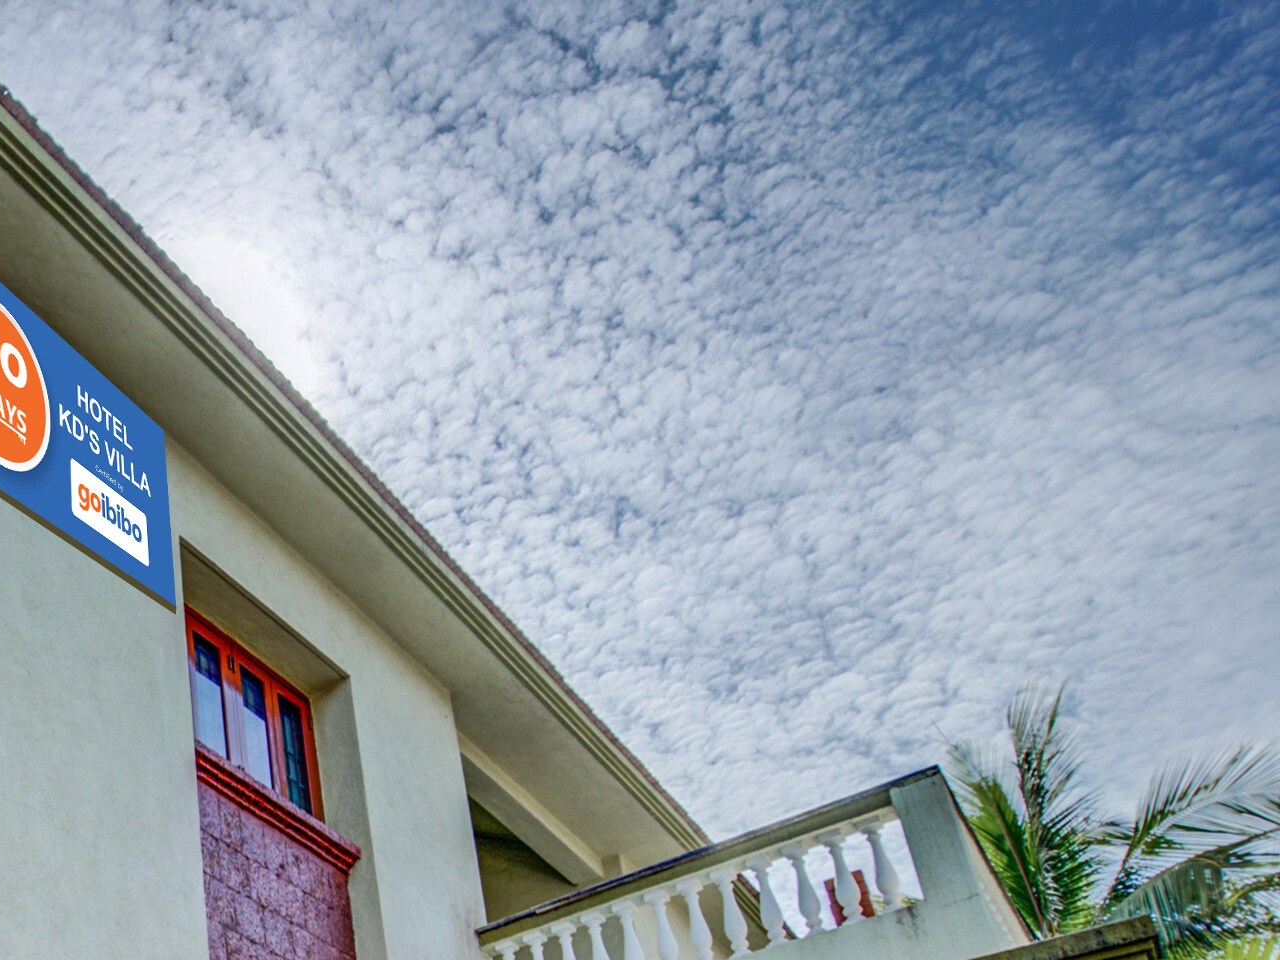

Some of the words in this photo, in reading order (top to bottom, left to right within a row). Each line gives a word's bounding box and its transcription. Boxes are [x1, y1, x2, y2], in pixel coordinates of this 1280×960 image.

[58, 402, 100, 455] KD'S
[104, 440, 151, 498] VILLA
[77, 384, 133, 451] HOTEL
[78, 483, 142, 543] goibibo
